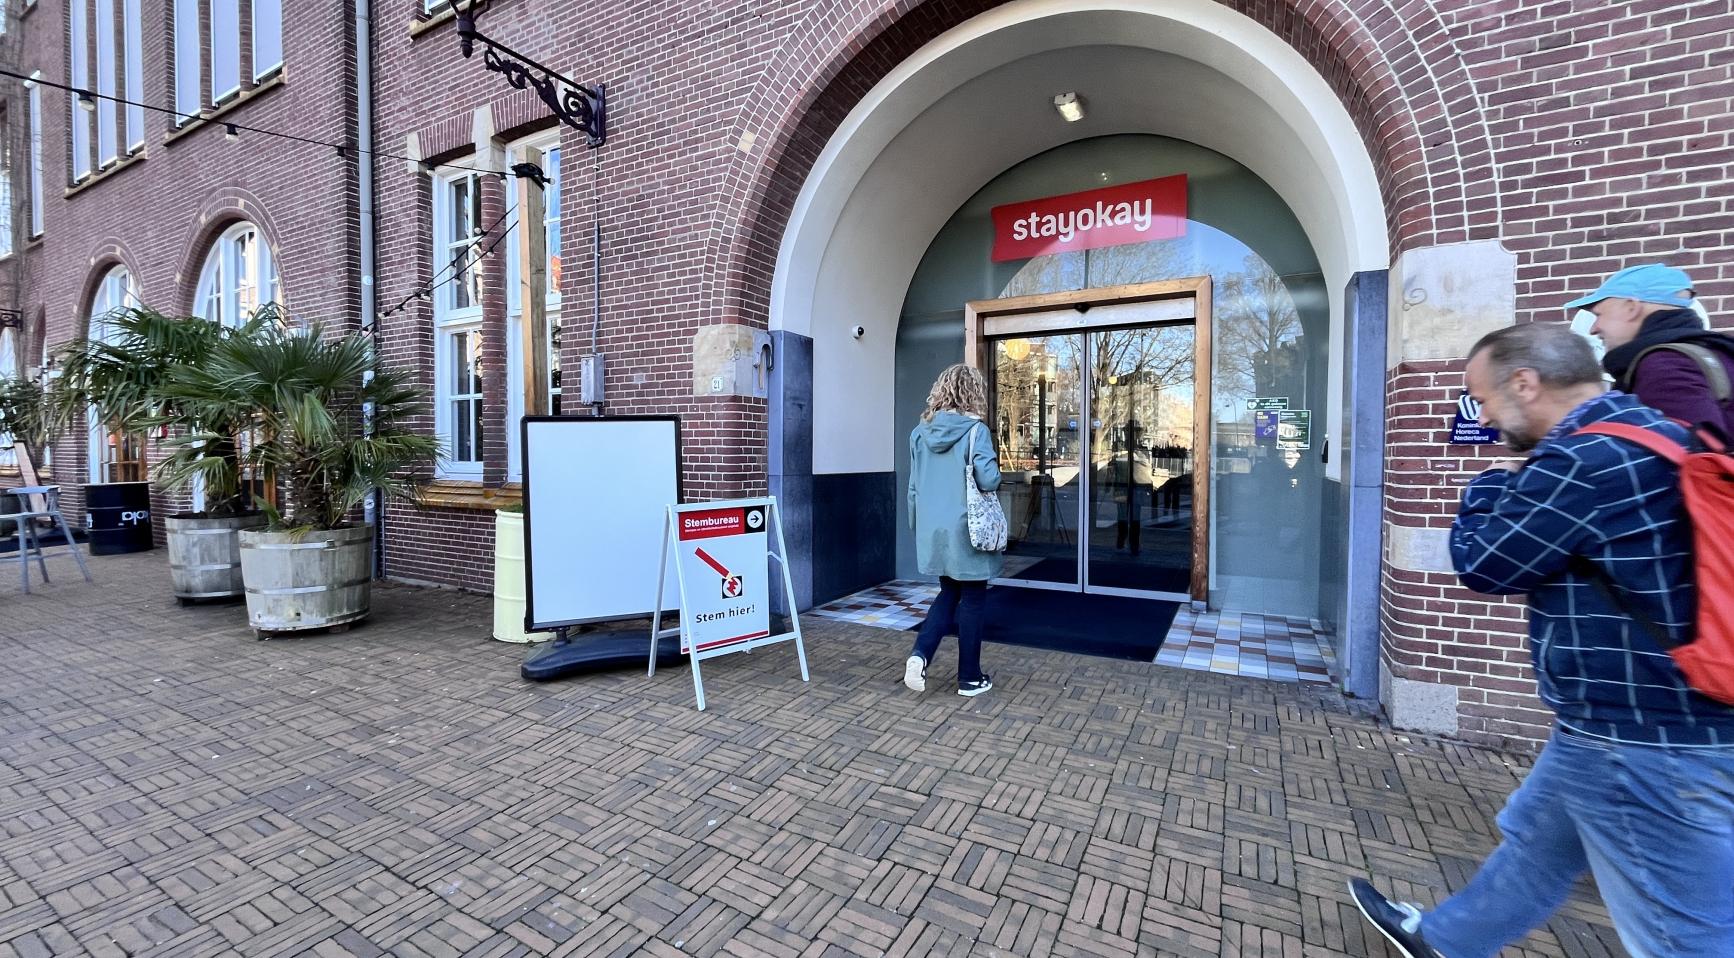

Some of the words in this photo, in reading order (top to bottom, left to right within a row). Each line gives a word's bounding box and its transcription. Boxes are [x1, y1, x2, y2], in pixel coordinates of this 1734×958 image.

[1013, 199, 1152, 243] stayokay
[713, 380, 720, 389] 21
[685, 516, 739, 528] Stembureau
[696, 610, 725, 624] Stem
[729, 604, 756, 618] hier!
